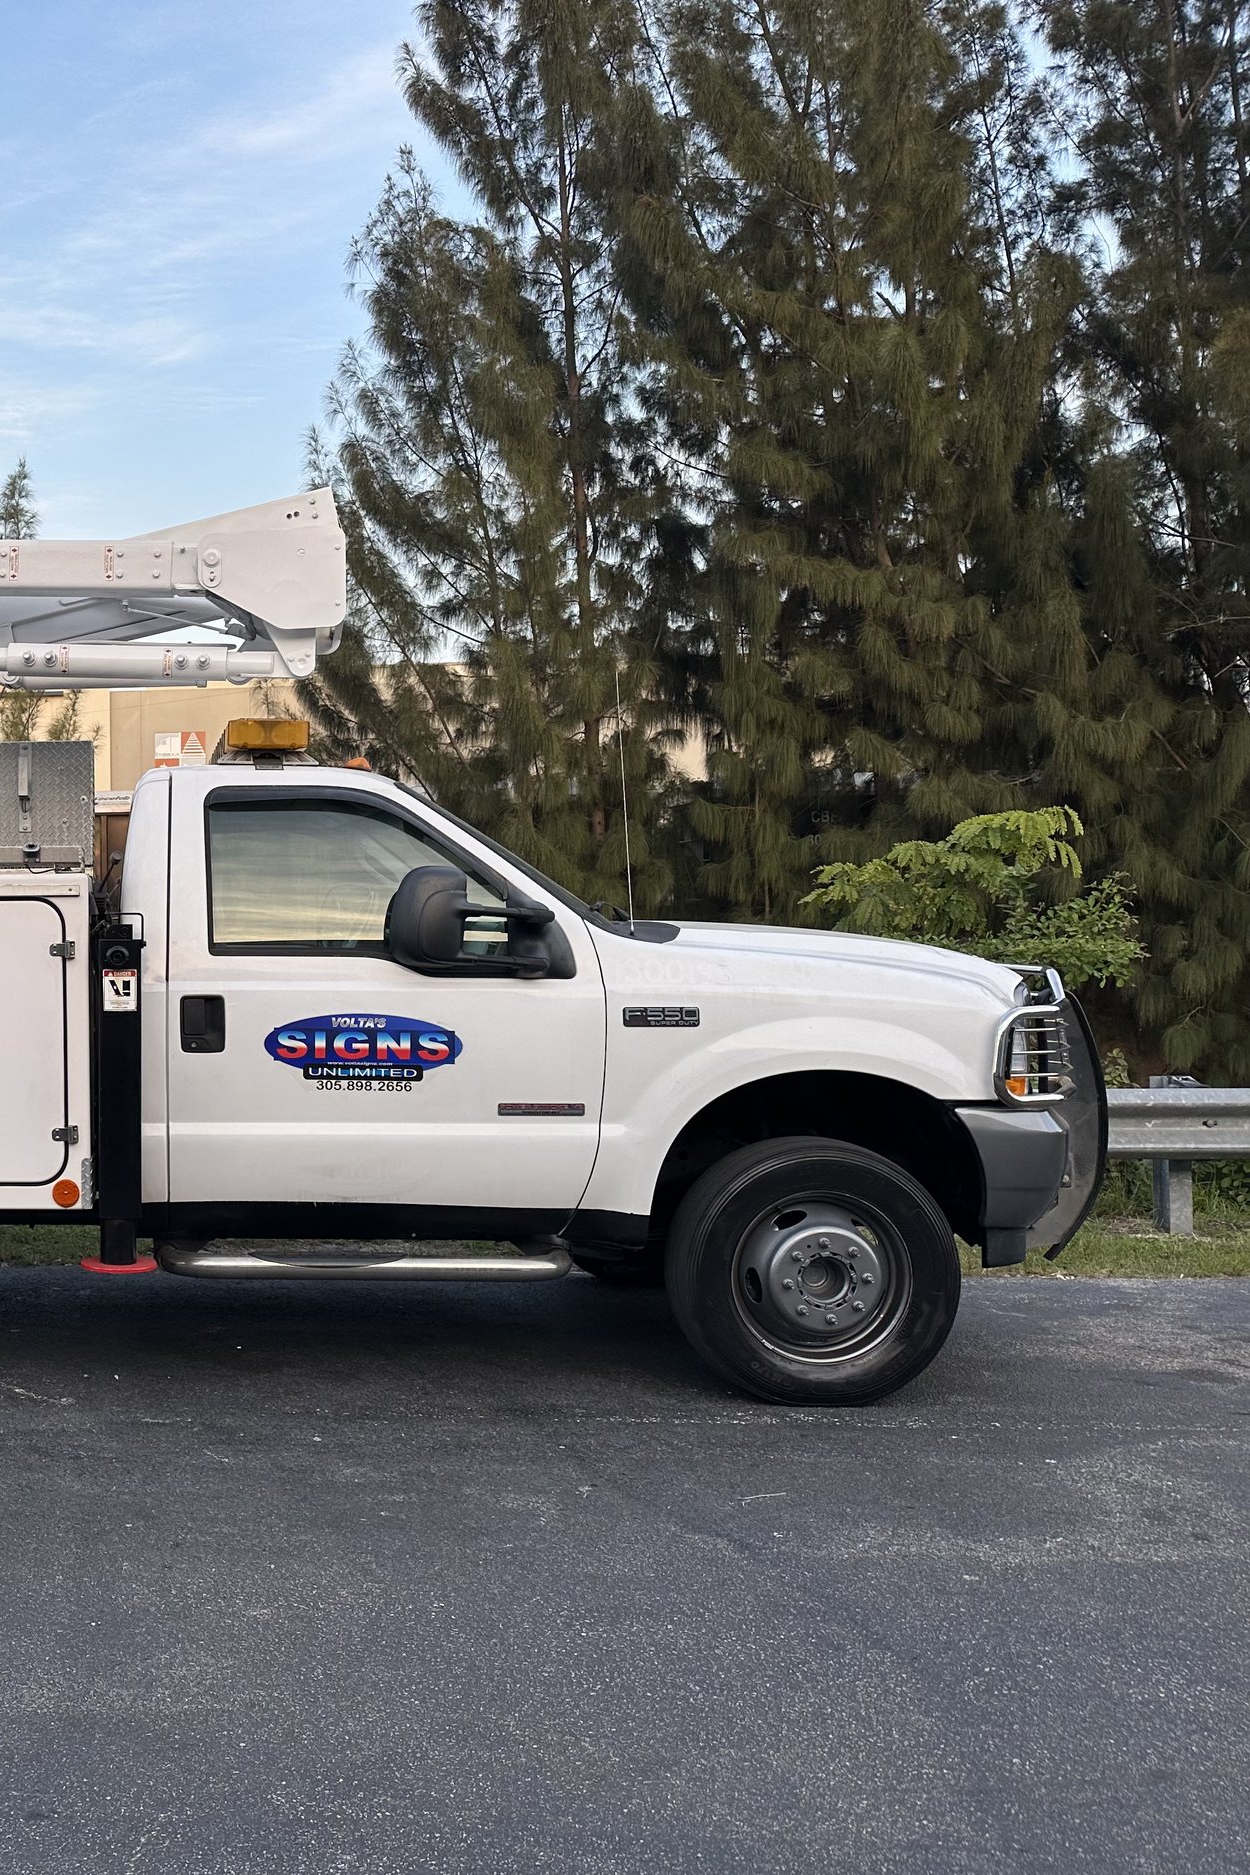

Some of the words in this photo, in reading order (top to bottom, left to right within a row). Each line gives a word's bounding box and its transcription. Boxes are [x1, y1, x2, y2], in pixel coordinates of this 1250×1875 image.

[331, 1017, 387, 1029] VOLTA'S
[276, 1030, 450, 1061] SIGNS
[308, 1066, 418, 1078] UNLIMITED
[316, 1080, 413, 1092] 305.898.2656
